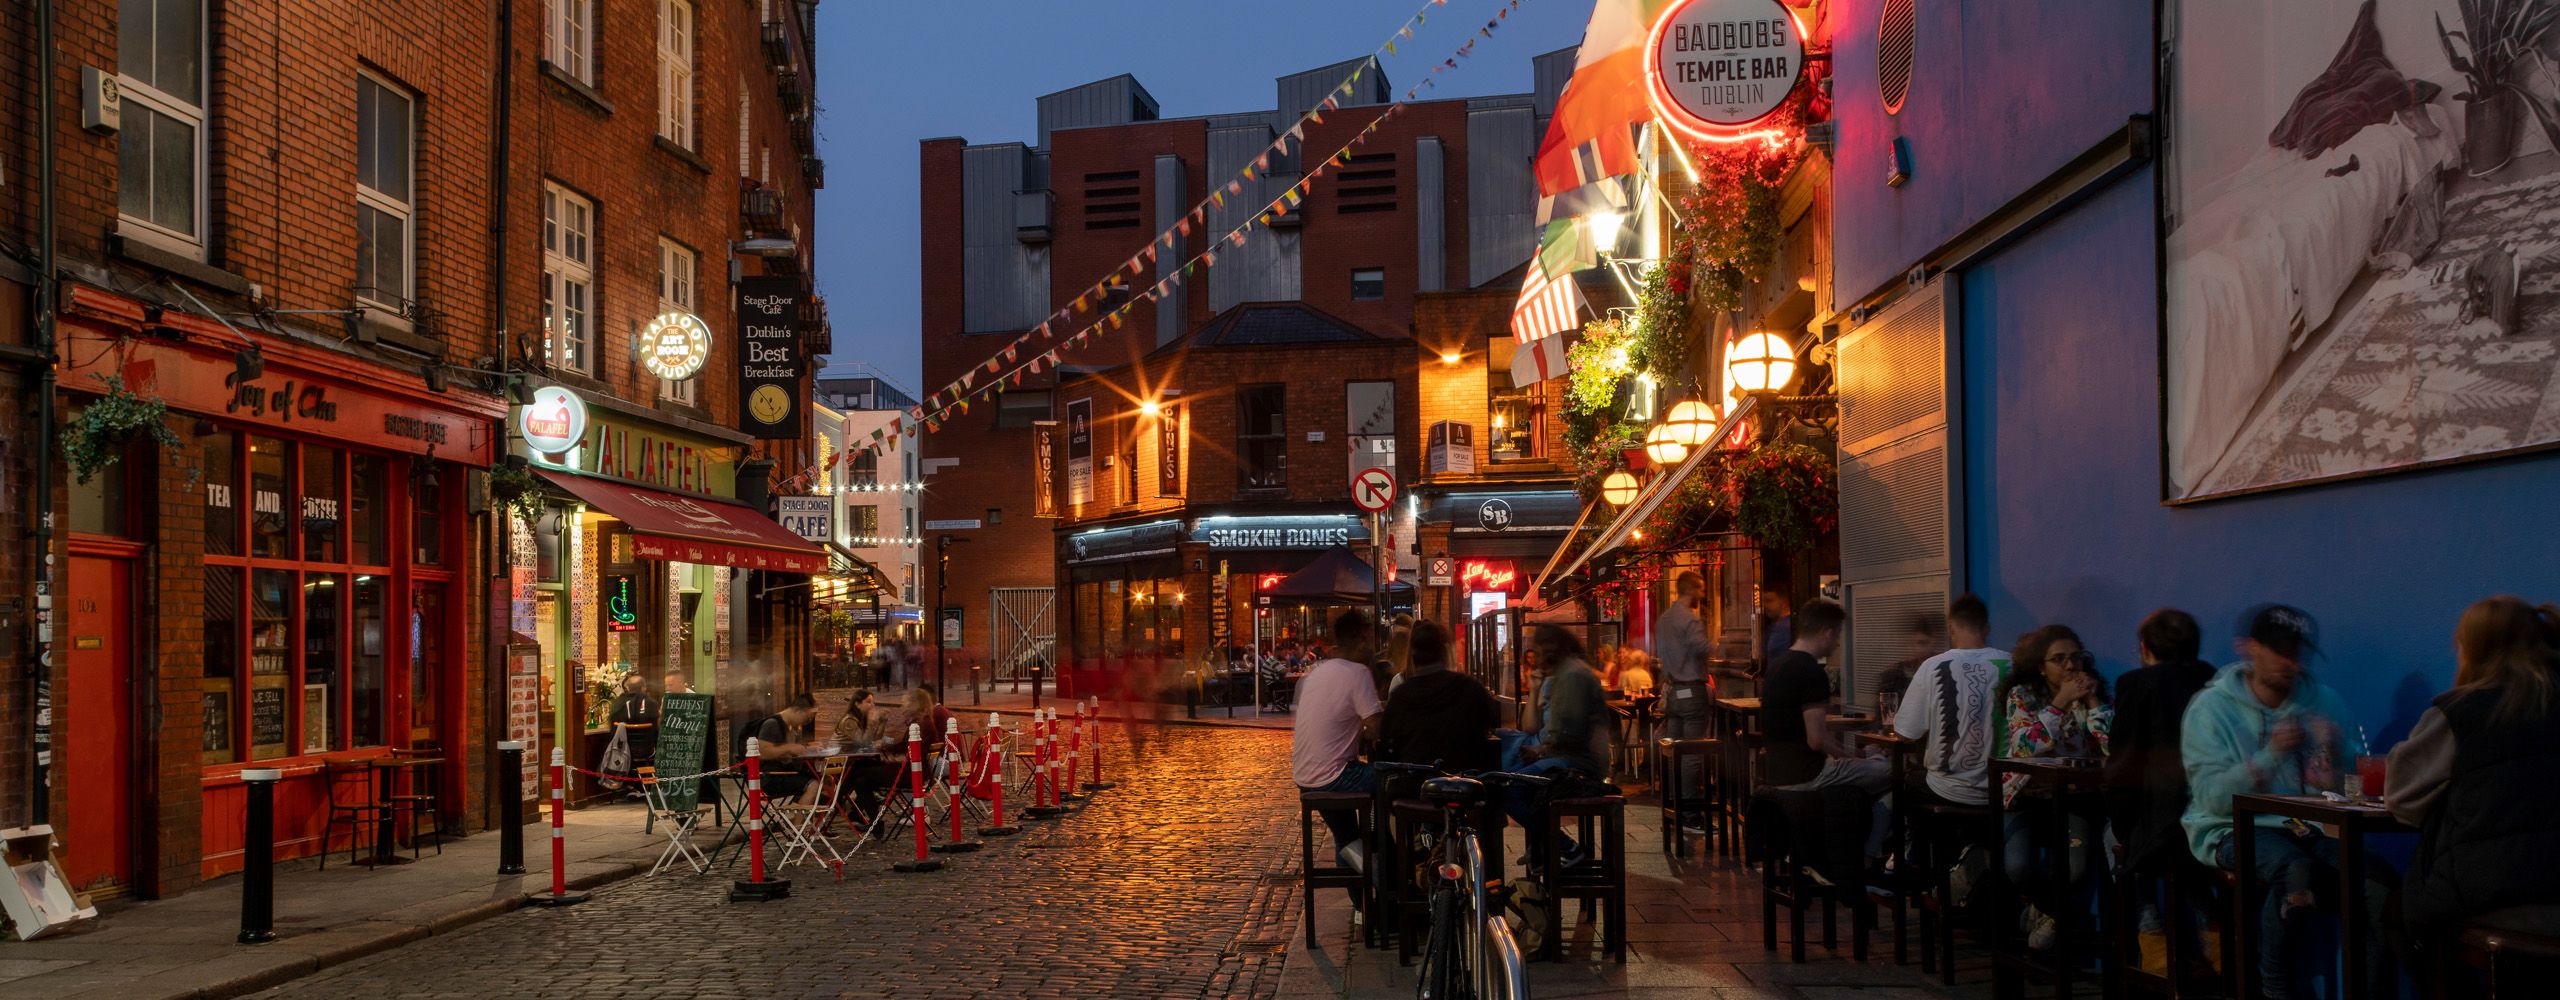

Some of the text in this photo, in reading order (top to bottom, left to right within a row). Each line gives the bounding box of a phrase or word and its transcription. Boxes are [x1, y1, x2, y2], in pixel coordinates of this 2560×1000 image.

[1675, 18, 1787, 52] BADBOBS
[1675, 56, 1788, 83] TEMPLE BAR
[1701, 83, 1764, 106] DUBLIN
[743, 295, 793, 309] Stage Door
[762, 304, 782, 315] Café
[642, 313, 703, 341] TATTOO
[746, 324, 791, 338] Dublin's
[656, 345, 690, 356] ROOM
[661, 335, 685, 345] ART
[748, 341, 789, 362] Best
[646, 355, 701, 378] STUDIO
[744, 365, 795, 378] Breakfast
[529, 420, 569, 435] FALAFEL
[1041, 431, 1052, 511] SMOKIN
[1069, 466, 1091, 478] FOR SALE
[207, 483, 231, 508] TEA
[255, 490, 280, 514] AND
[782, 499, 830, 511] STAGE DOOR
[782, 514, 828, 537] CAFÉ
[1208, 527, 1348, 548] SMOKIN BONES
[78, 598, 97, 614] 10A
[665, 713, 701, 735] Menu
